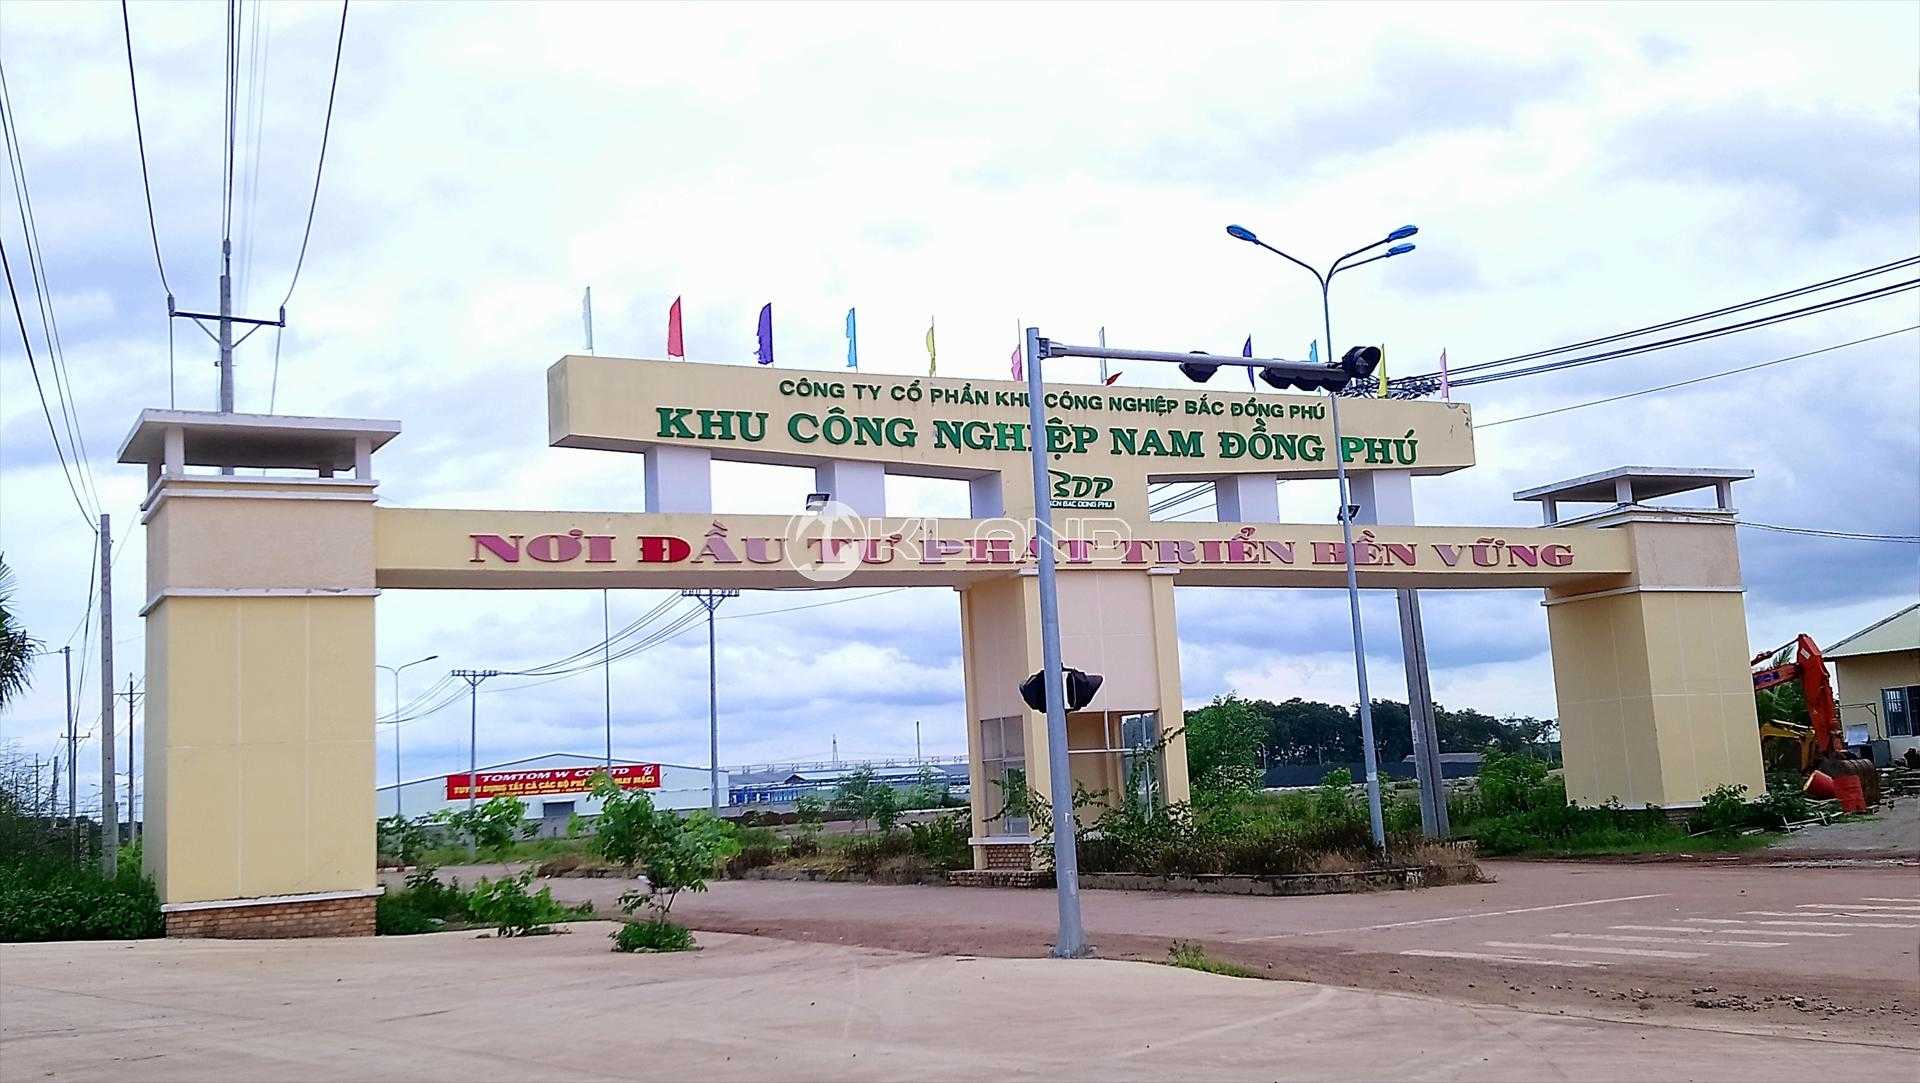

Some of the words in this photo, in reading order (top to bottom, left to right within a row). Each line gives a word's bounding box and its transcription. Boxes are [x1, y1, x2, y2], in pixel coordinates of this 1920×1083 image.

[780, 378, 845, 398] CÔNG
[853, 384, 881, 400] TY
[891, 380, 922, 401] CỔ
[930, 382, 989, 405] PHẦN
[1044, 391, 1103, 410] CÔNG
[1109, 396, 1178, 416] NGHIỆP
[1185, 393, 1224, 415] BẮC
[1289, 403, 1325, 419] PHÚ
[656, 407, 768, 441] KHU
[787, 406, 918, 447] CÔNG
[1109, 428, 1203, 458] NAM
[1218, 418, 1325, 461] ĐỒNG
[1341, 429, 1418, 465] PHÚ
[470, 529, 617, 563] NƠI
[638, 520, 788, 564] ĐẦU
[1113, 528, 1295, 565] TRIỂN
[1310, 530, 1417, 566] BỀN
[1431, 537, 1574, 567] VỮNG
[481, 772, 551, 782] TOMTOM
